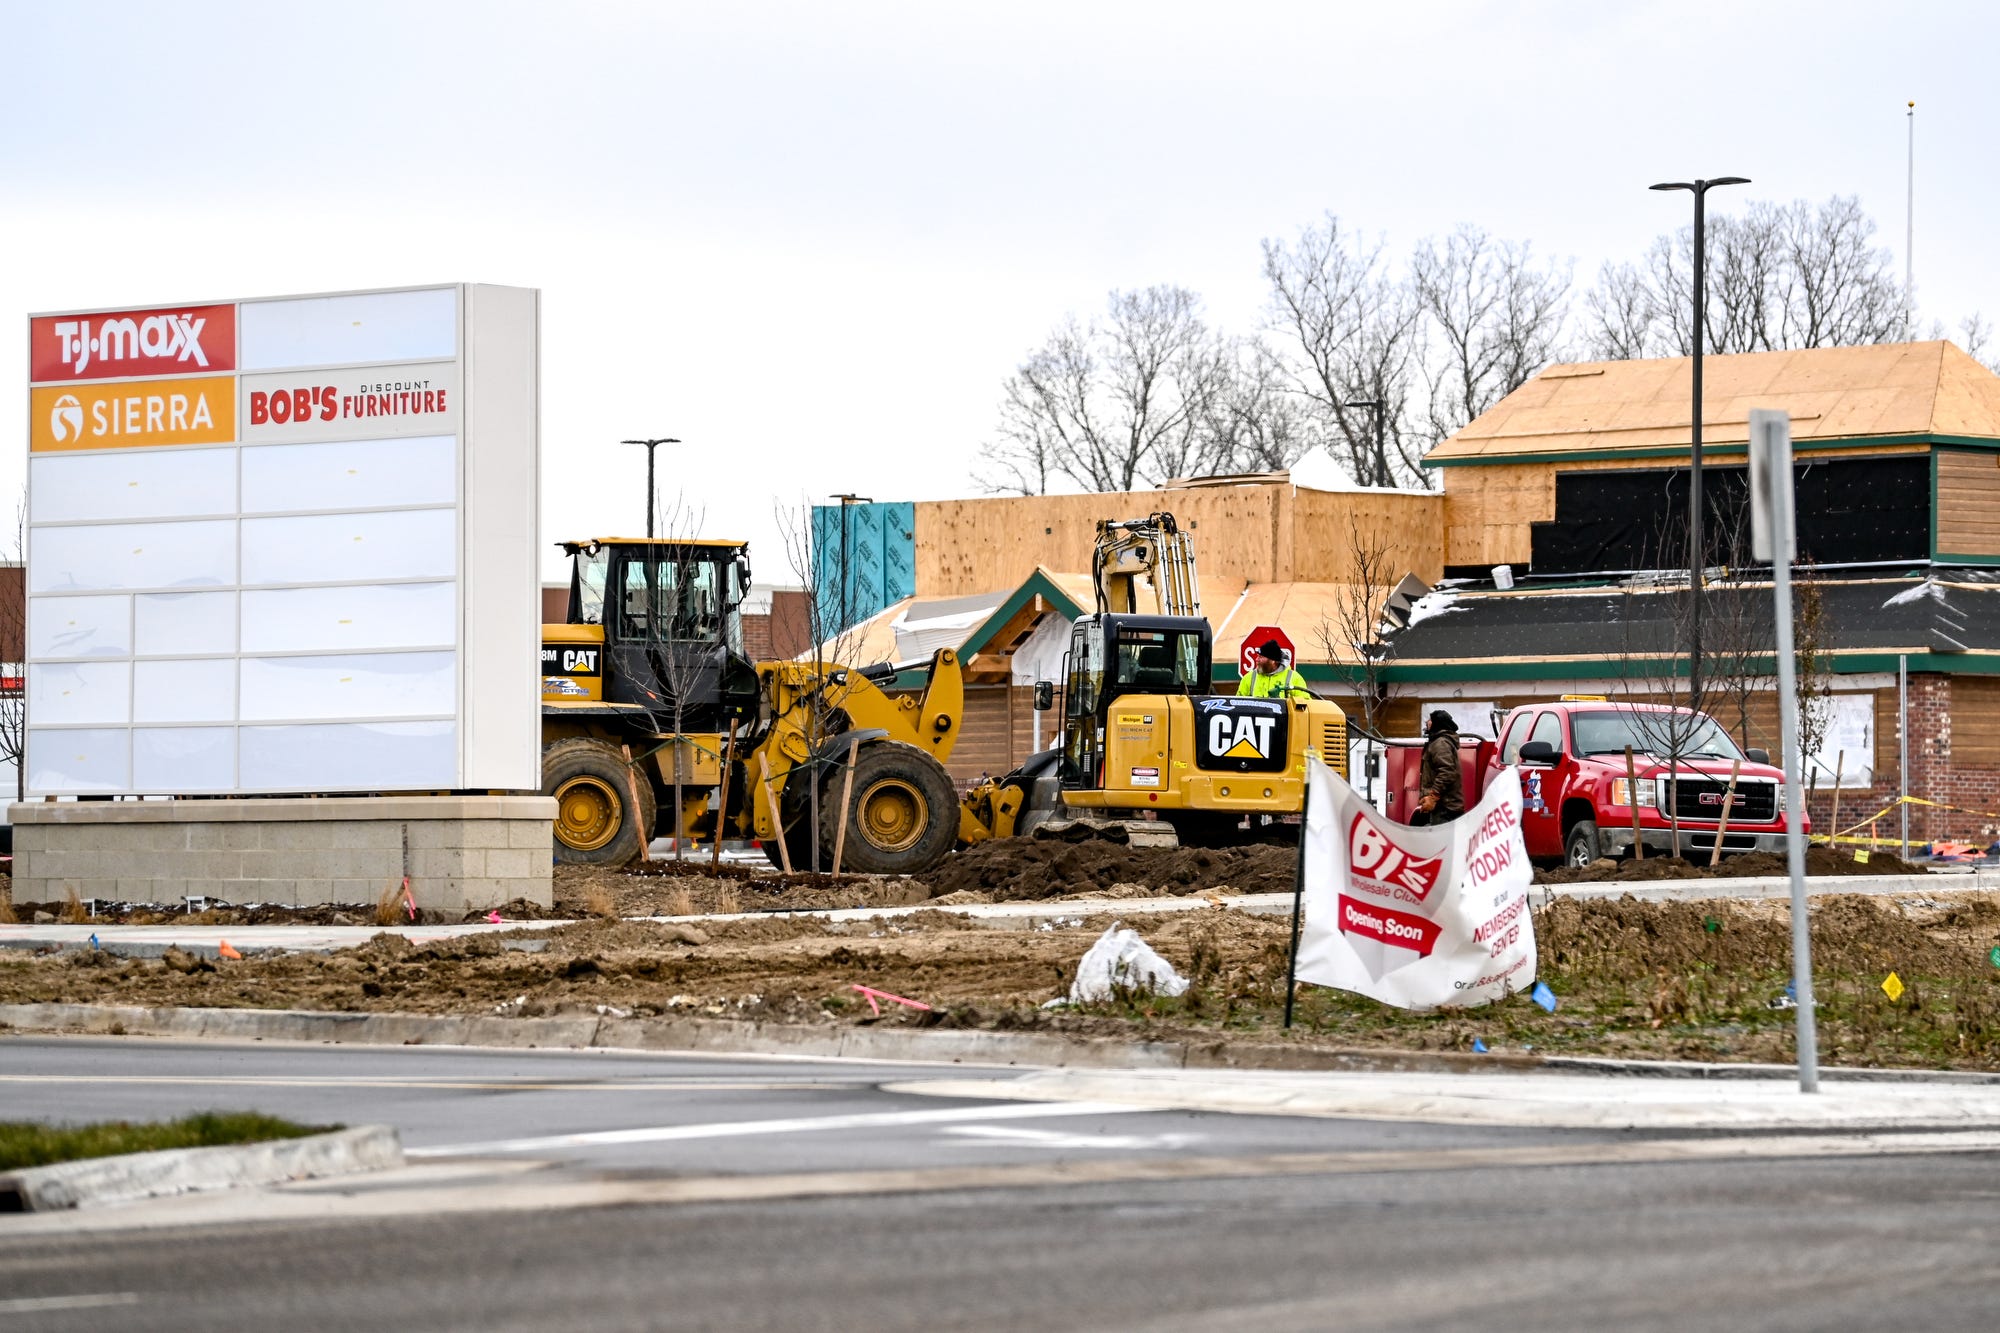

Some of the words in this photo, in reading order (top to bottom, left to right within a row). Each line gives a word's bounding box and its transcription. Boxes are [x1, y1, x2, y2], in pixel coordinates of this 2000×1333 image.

[250, 386, 338, 425] BOB'S
[343, 389, 447, 419] FURNITURE
[360, 380, 430, 393] DISCOUNT
[92, 392, 214, 436] SIERRA
[563, 650, 597, 671] CAT
[1209, 714, 1276, 759] CAT
[1480, 801, 1516, 843] HERE
[1469, 840, 1511, 887] TODAY
[1345, 904, 1384, 934] Opening
[1384, 918, 1424, 941] Soon
[1454, 980, 1466, 989] Or
